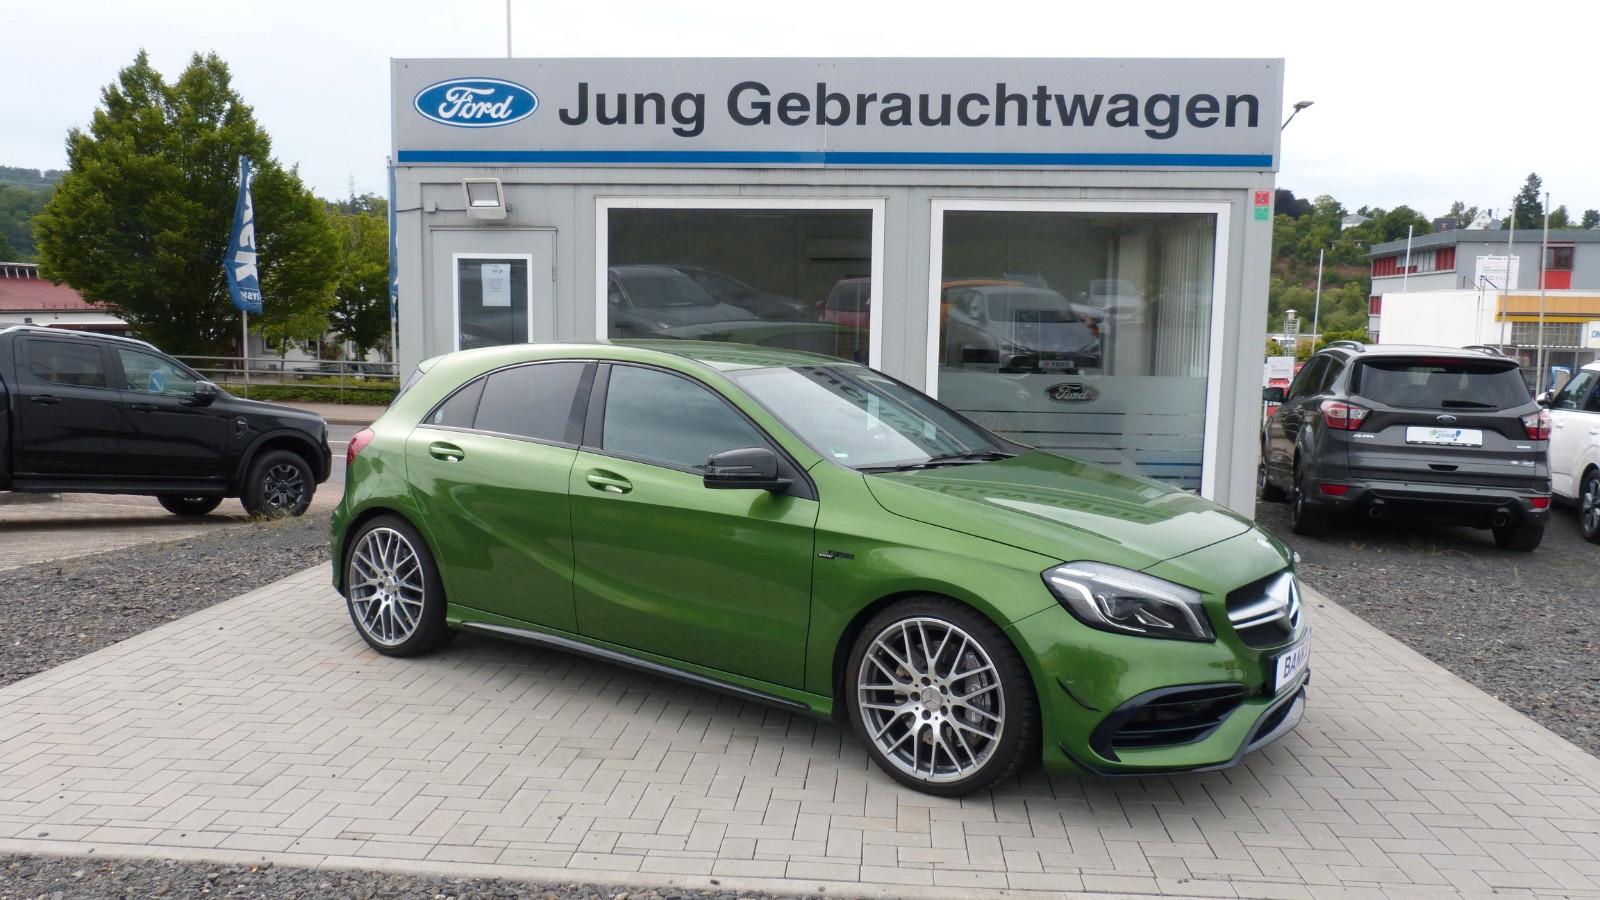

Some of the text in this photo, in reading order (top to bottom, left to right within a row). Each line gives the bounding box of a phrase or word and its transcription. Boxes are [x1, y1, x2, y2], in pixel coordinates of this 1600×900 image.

[438, 86, 514, 120] Ford
[559, 82, 1258, 139] Jung Gebrauchtwagen
[1056, 384, 1088, 400] Ford
